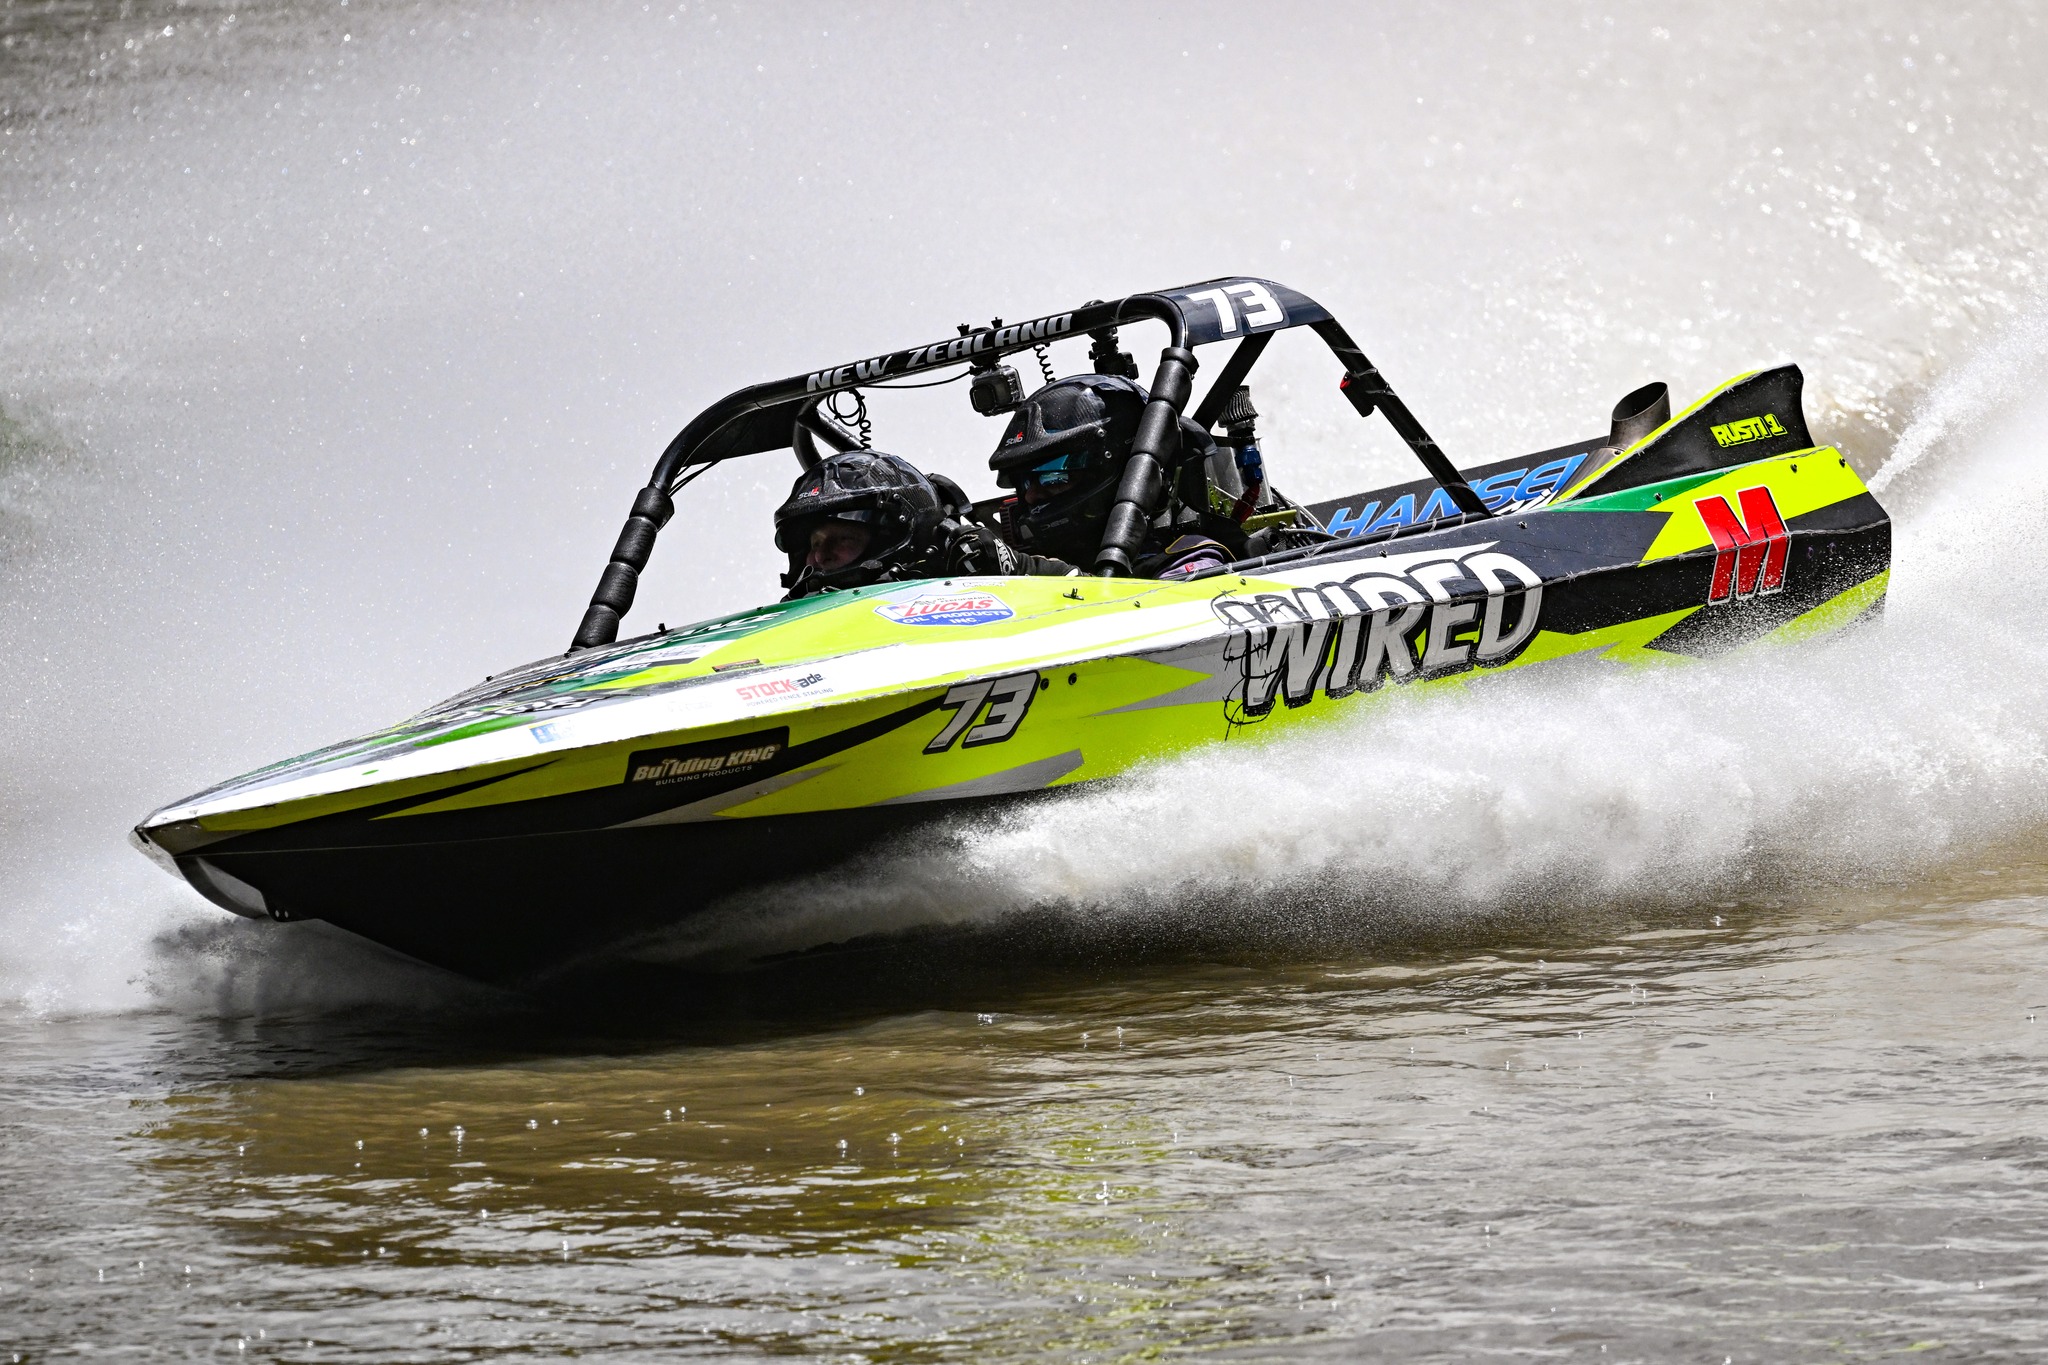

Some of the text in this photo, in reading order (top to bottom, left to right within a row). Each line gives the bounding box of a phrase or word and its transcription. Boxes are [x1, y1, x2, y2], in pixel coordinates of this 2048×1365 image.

[1185, 281, 1286, 335] 73
[806, 313, 1072, 392] NEW ZEALAND
[1692, 484, 1792, 606] M
[902, 610, 1011, 624] OIL PRODUCTS
[904, 599, 994, 617] LUCAS
[1214, 550, 1544, 717] WIRED
[746, 687, 834, 707] POWERED FENCE STAPLING
[922, 669, 1041, 755] 73
[655, 764, 752, 786] BUILDING PRODUCTS
[726, 745, 777, 768] KING
